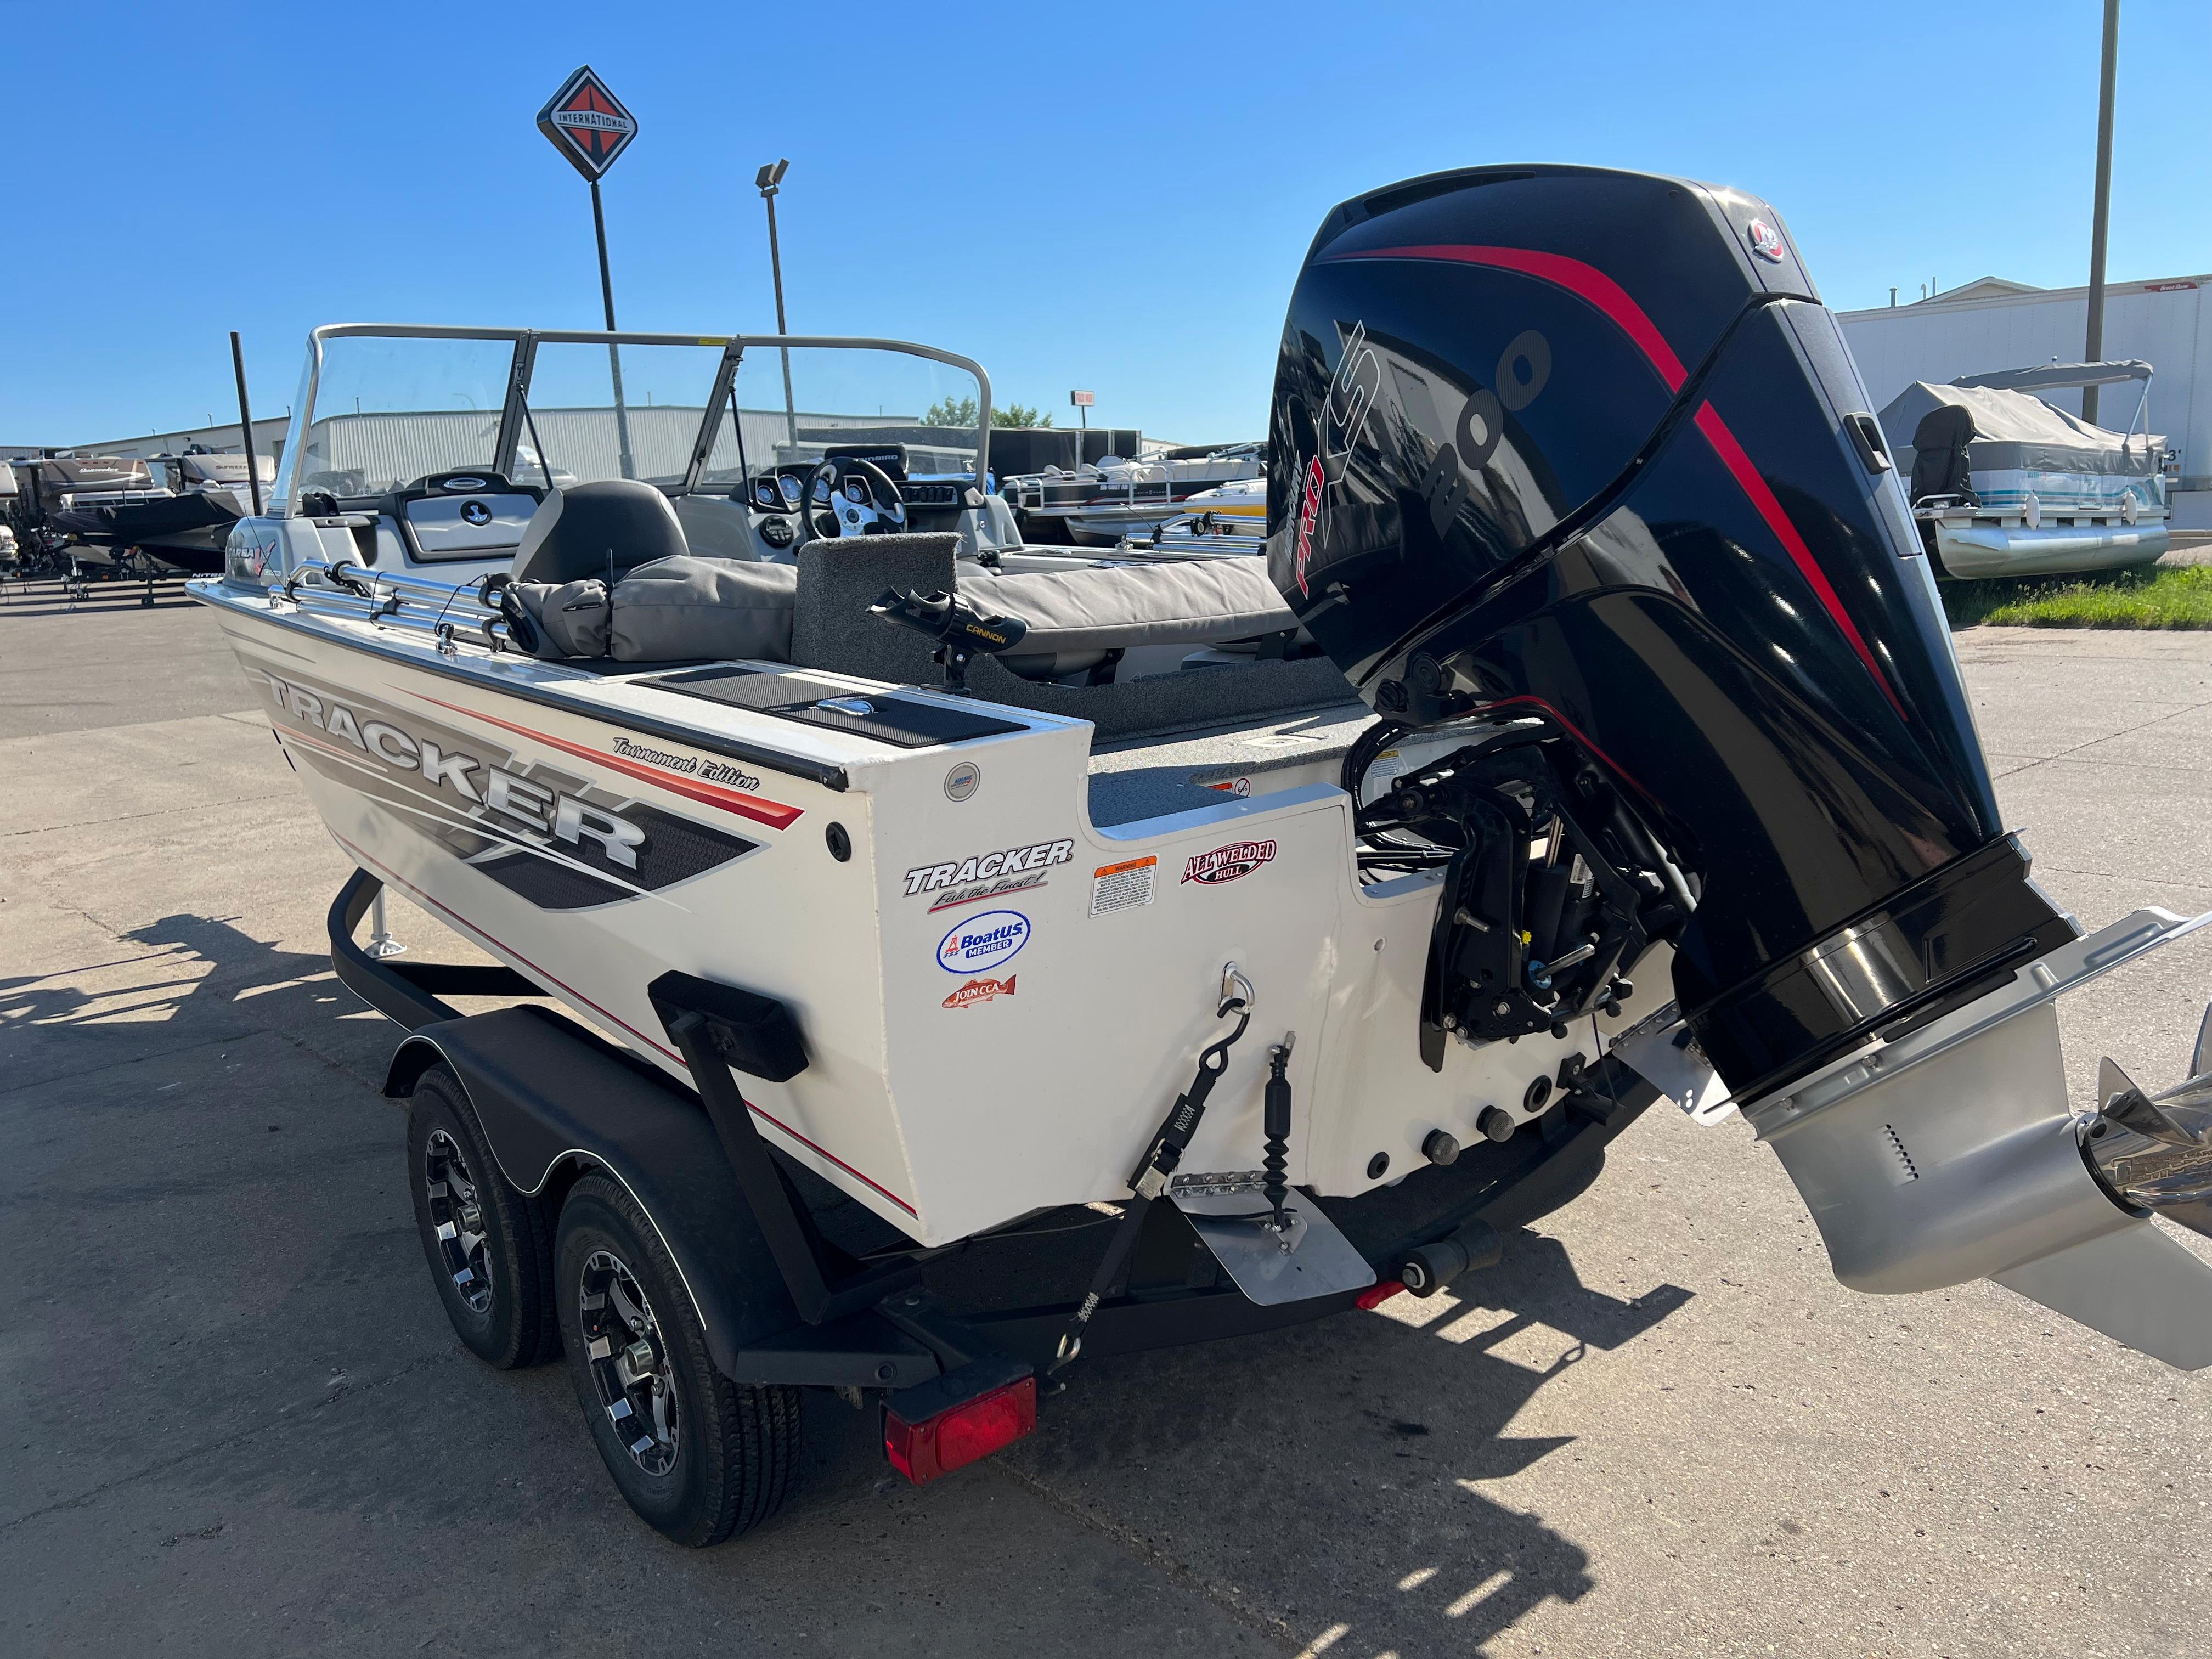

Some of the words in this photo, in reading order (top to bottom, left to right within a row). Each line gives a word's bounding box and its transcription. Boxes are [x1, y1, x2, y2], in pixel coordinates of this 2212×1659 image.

[558, 113, 628, 128] INTERNATIONAL
[1419, 329, 1553, 541] 200
[2166, 449, 2182, 461] 3'
[1296, 454, 1325, 601] PRO
[966, 624, 1006, 644] CANNON
[268, 677, 646, 871] TRACKER
[613, 737, 697, 773] Tournament
[697, 759, 760, 791] Edition
[905, 839, 1073, 895] TRACKER
[1115, 862, 1137, 872] WARNING
[1182, 855, 1215, 879] ALL
[1217, 841, 1276, 868] WELDED
[1215, 866, 1242, 881] HULL
[934, 890, 965, 906] Fish
[968, 885, 988, 899] the
[969, 940, 1009, 957] MEMBER
[954, 987, 979, 1002] JOIN
[979, 983, 999, 995] CCA
